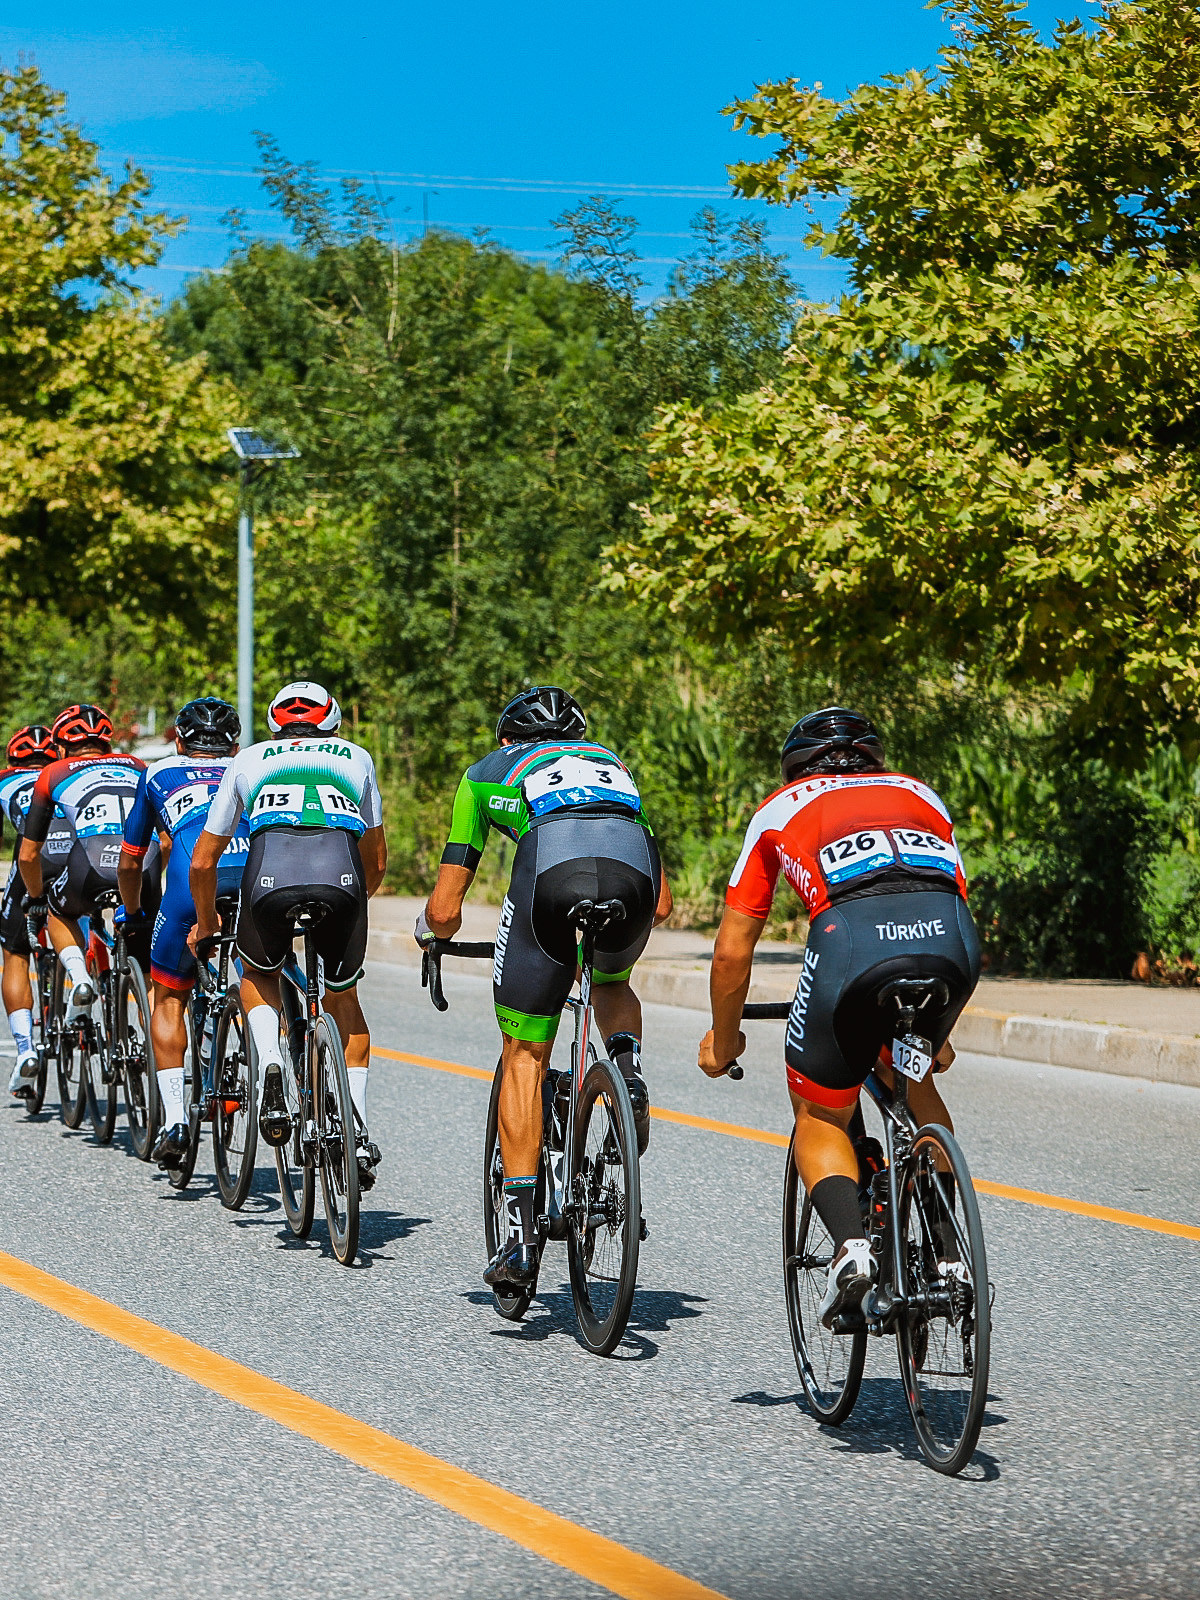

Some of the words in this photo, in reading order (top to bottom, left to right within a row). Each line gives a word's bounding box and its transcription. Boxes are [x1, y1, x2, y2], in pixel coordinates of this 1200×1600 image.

[262, 743, 352, 760] ALGERIA
[546, 769, 563, 786] 3
[594, 769, 613, 784] 3
[173, 792, 194, 815] 75
[258, 792, 290, 809] 113
[327, 794, 360, 814] 113
[84, 803, 108, 820] 85
[821, 832, 877, 865] 126
[893, 830, 946, 851] 126
[875, 919, 946, 942] TÜRKİYE
[786, 947, 820, 1053] TÜRKİYE
[898, 1046, 921, 1075] 126
